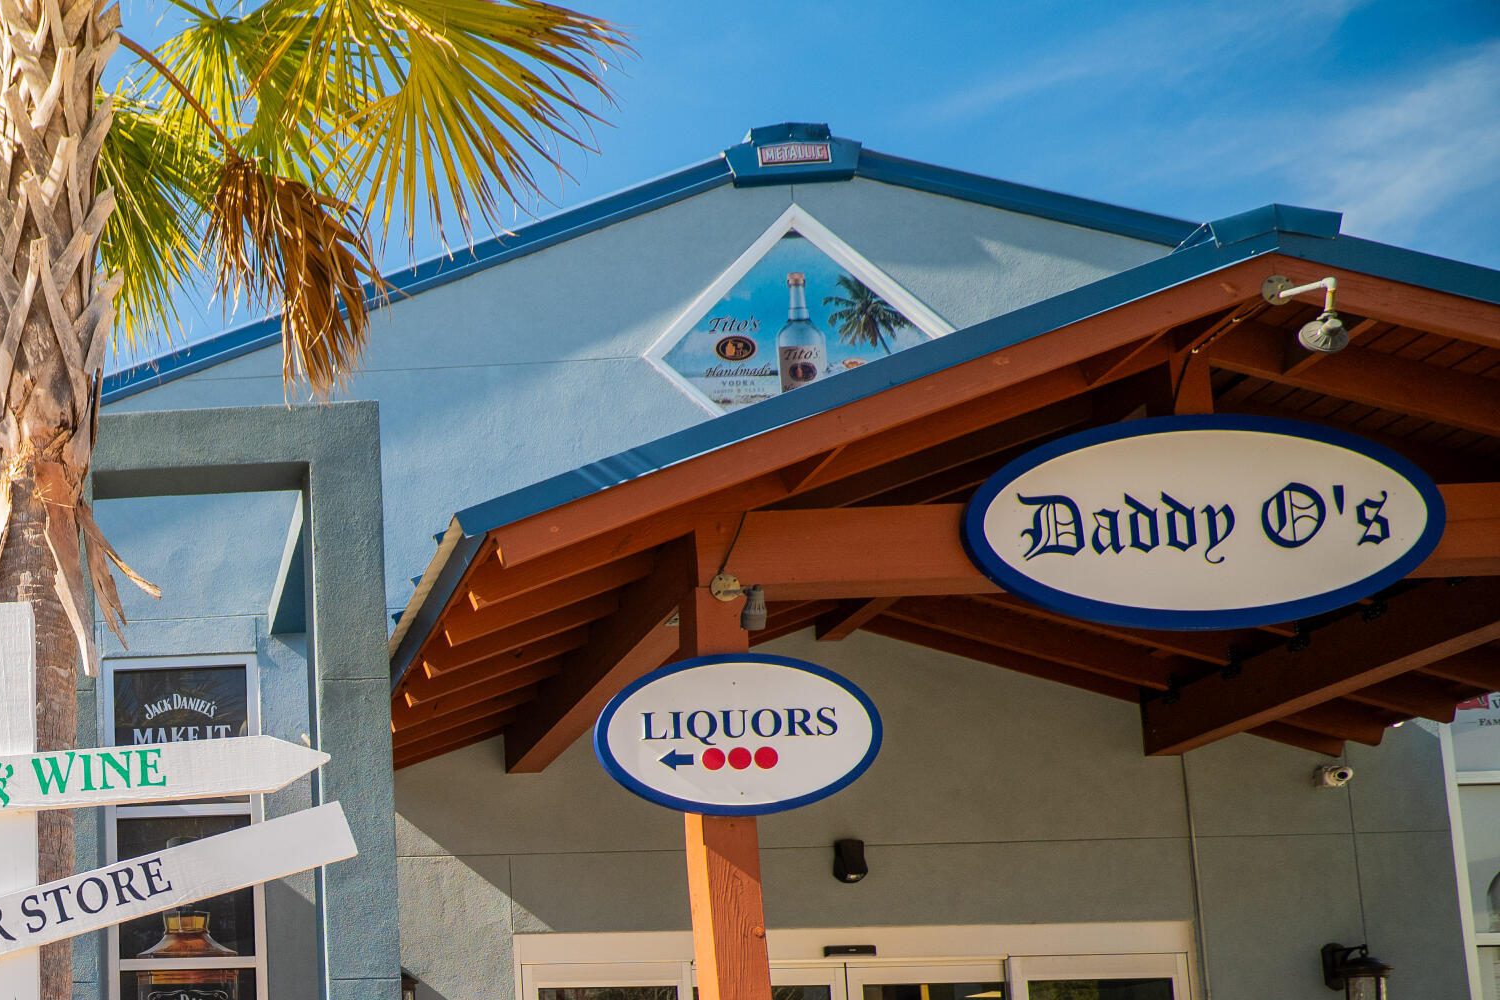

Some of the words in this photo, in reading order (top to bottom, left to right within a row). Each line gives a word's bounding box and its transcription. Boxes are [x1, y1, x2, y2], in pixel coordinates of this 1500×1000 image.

[708, 315, 760, 334] Tito's
[784, 347, 821, 361] Tito's
[705, 362, 772, 377] Handmade
[1016, 490, 1236, 565] Daddy
[1261, 482, 1390, 549] O's
[144, 697, 173, 720] JACK
[172, 693, 218, 719] DANIEL'S
[132, 725, 201, 745] MAKE
[205, 724, 232, 739] IT
[640, 706, 838, 746] LIQUORS
[31, 748, 168, 796] WINE
[20, 857, 173, 935] STORE
